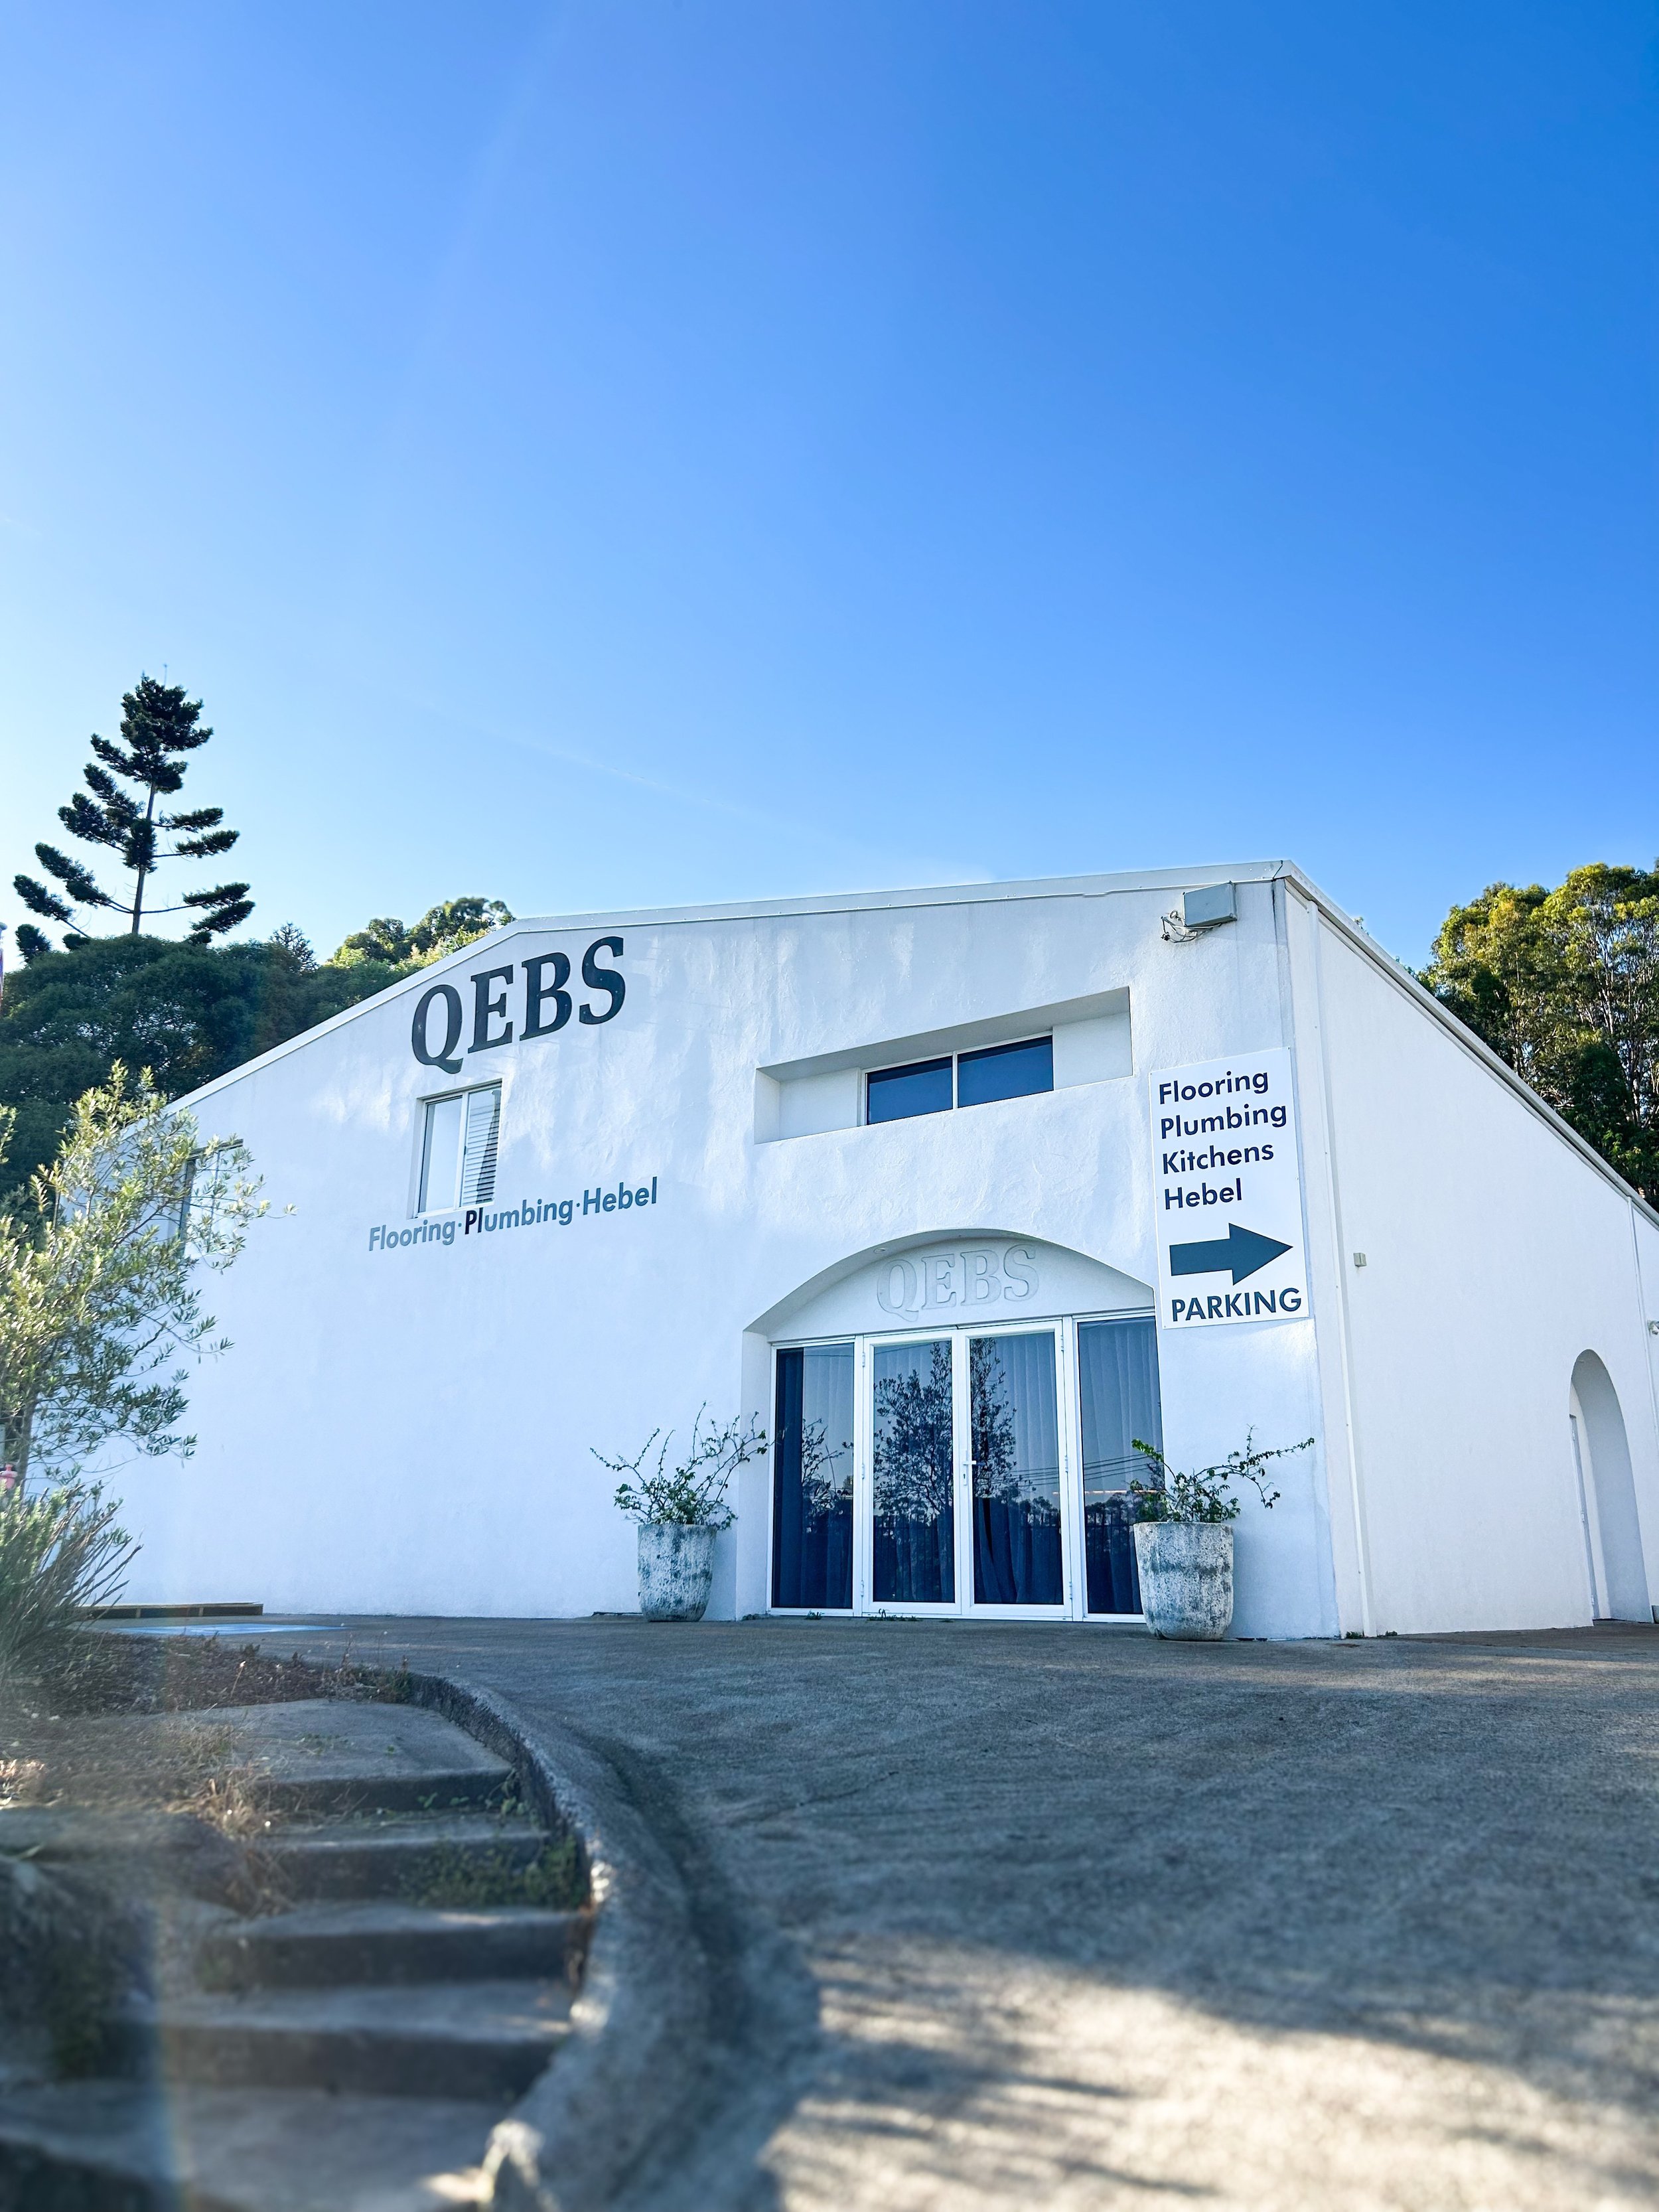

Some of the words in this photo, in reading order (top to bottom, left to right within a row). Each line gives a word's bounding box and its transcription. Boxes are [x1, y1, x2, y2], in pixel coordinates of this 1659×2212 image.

[411, 936, 626, 1074] QEBS
[1159, 1070, 1269, 1104] Flooring
[1161, 1103, 1287, 1139] Plumbing
[1163, 1143, 1274, 1174] Kitchens
[1165, 1177, 1242, 1210] Hebel
[877, 1244, 1039, 1322] QEBS
[1171, 1288, 1302, 1322] PARKING
